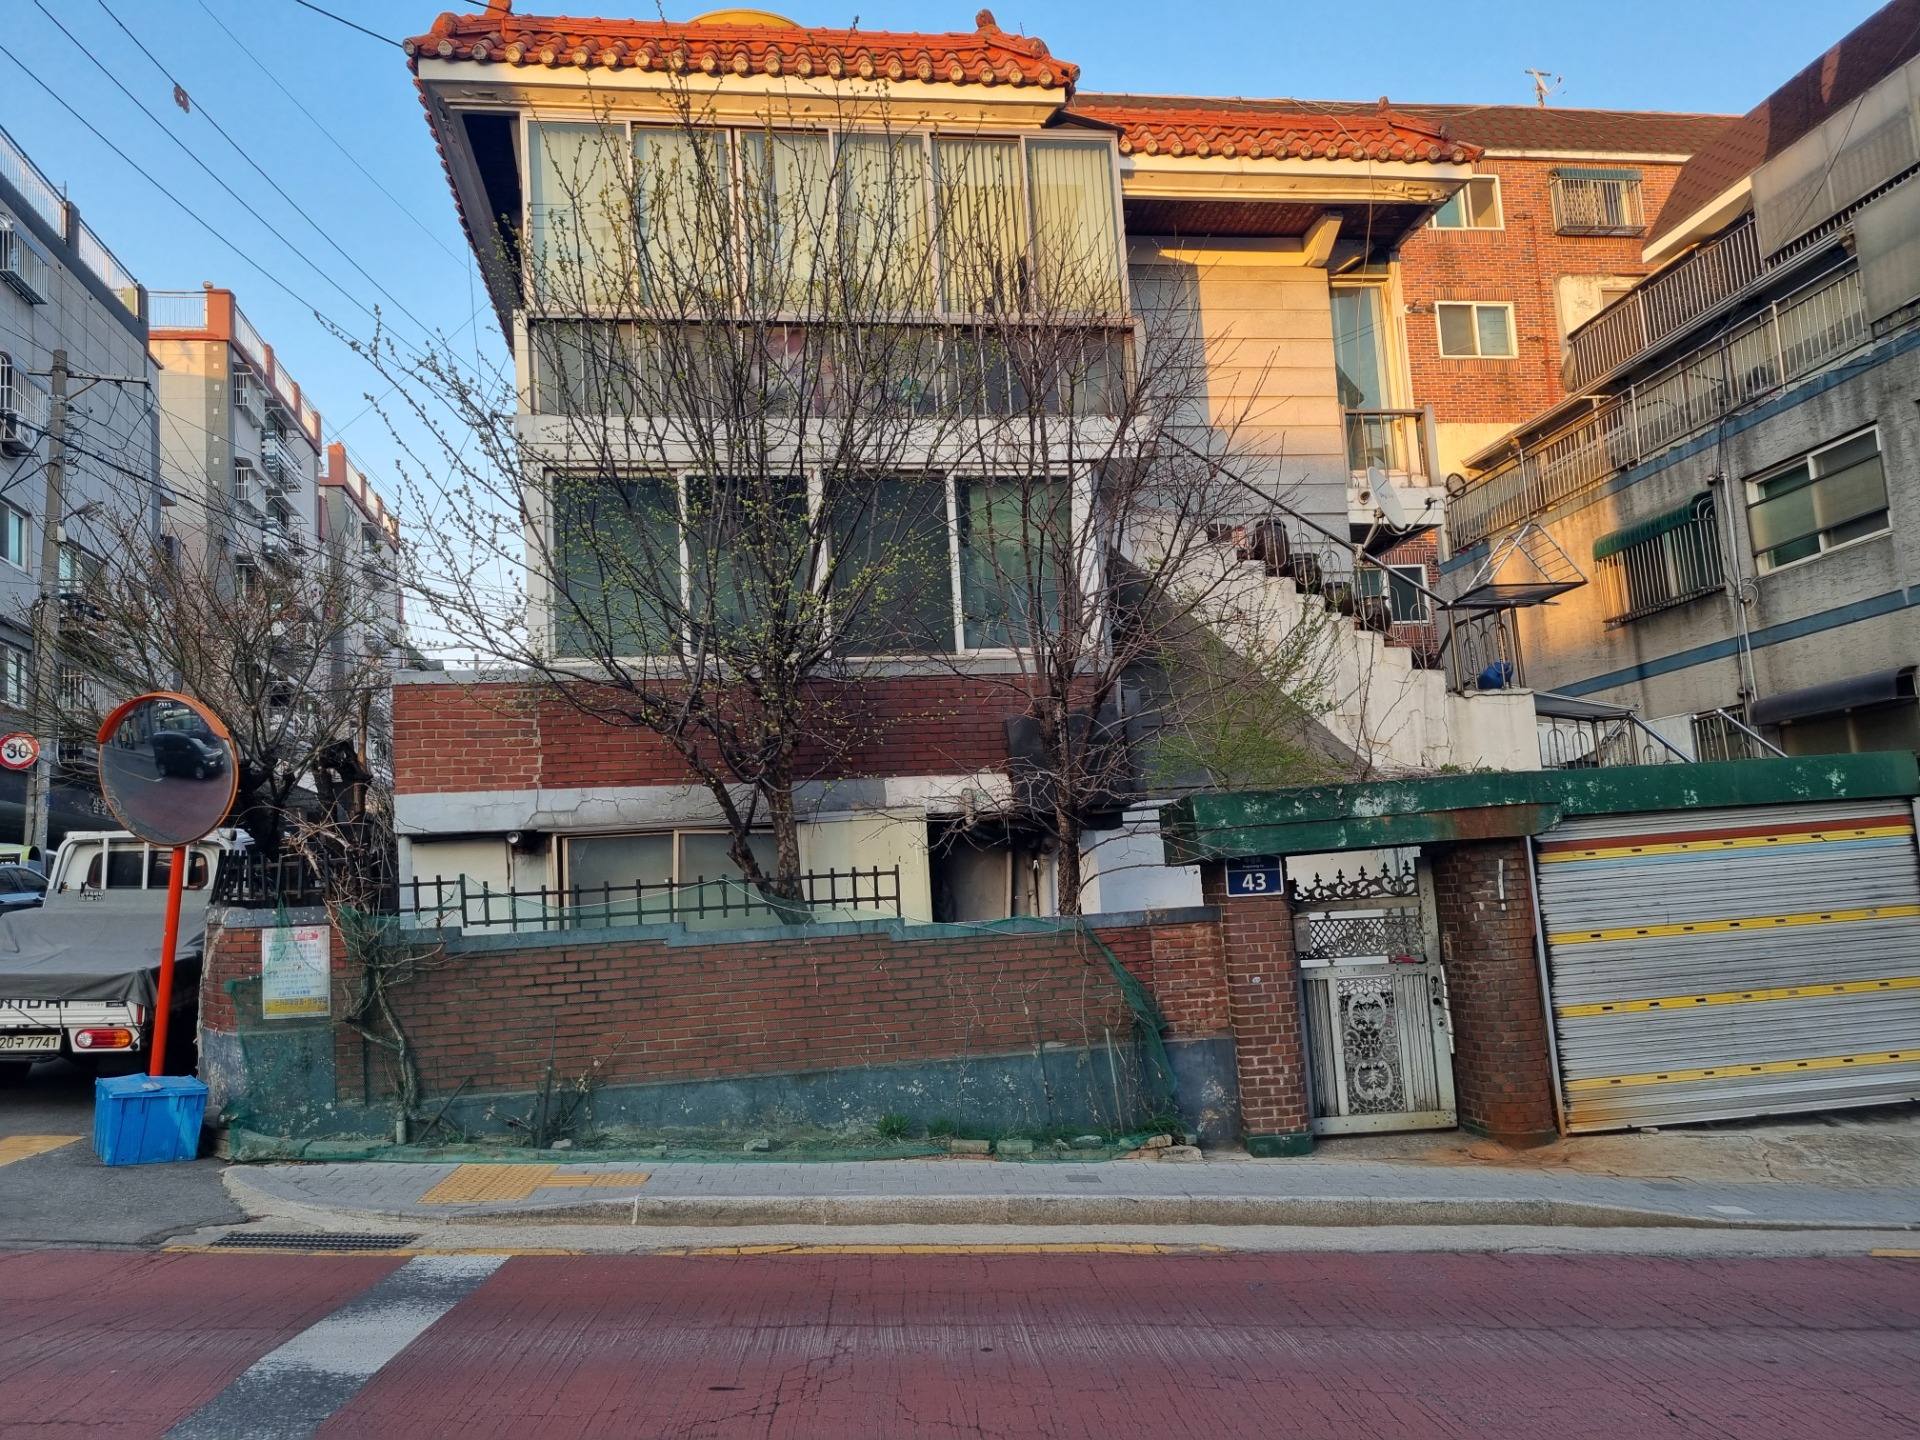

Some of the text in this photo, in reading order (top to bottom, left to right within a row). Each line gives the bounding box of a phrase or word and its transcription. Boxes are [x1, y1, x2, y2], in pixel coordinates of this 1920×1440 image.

[6, 743, 28, 759] 30
[1242, 872, 1267, 891] 43
[27, 1036, 57, 1049] 7741
